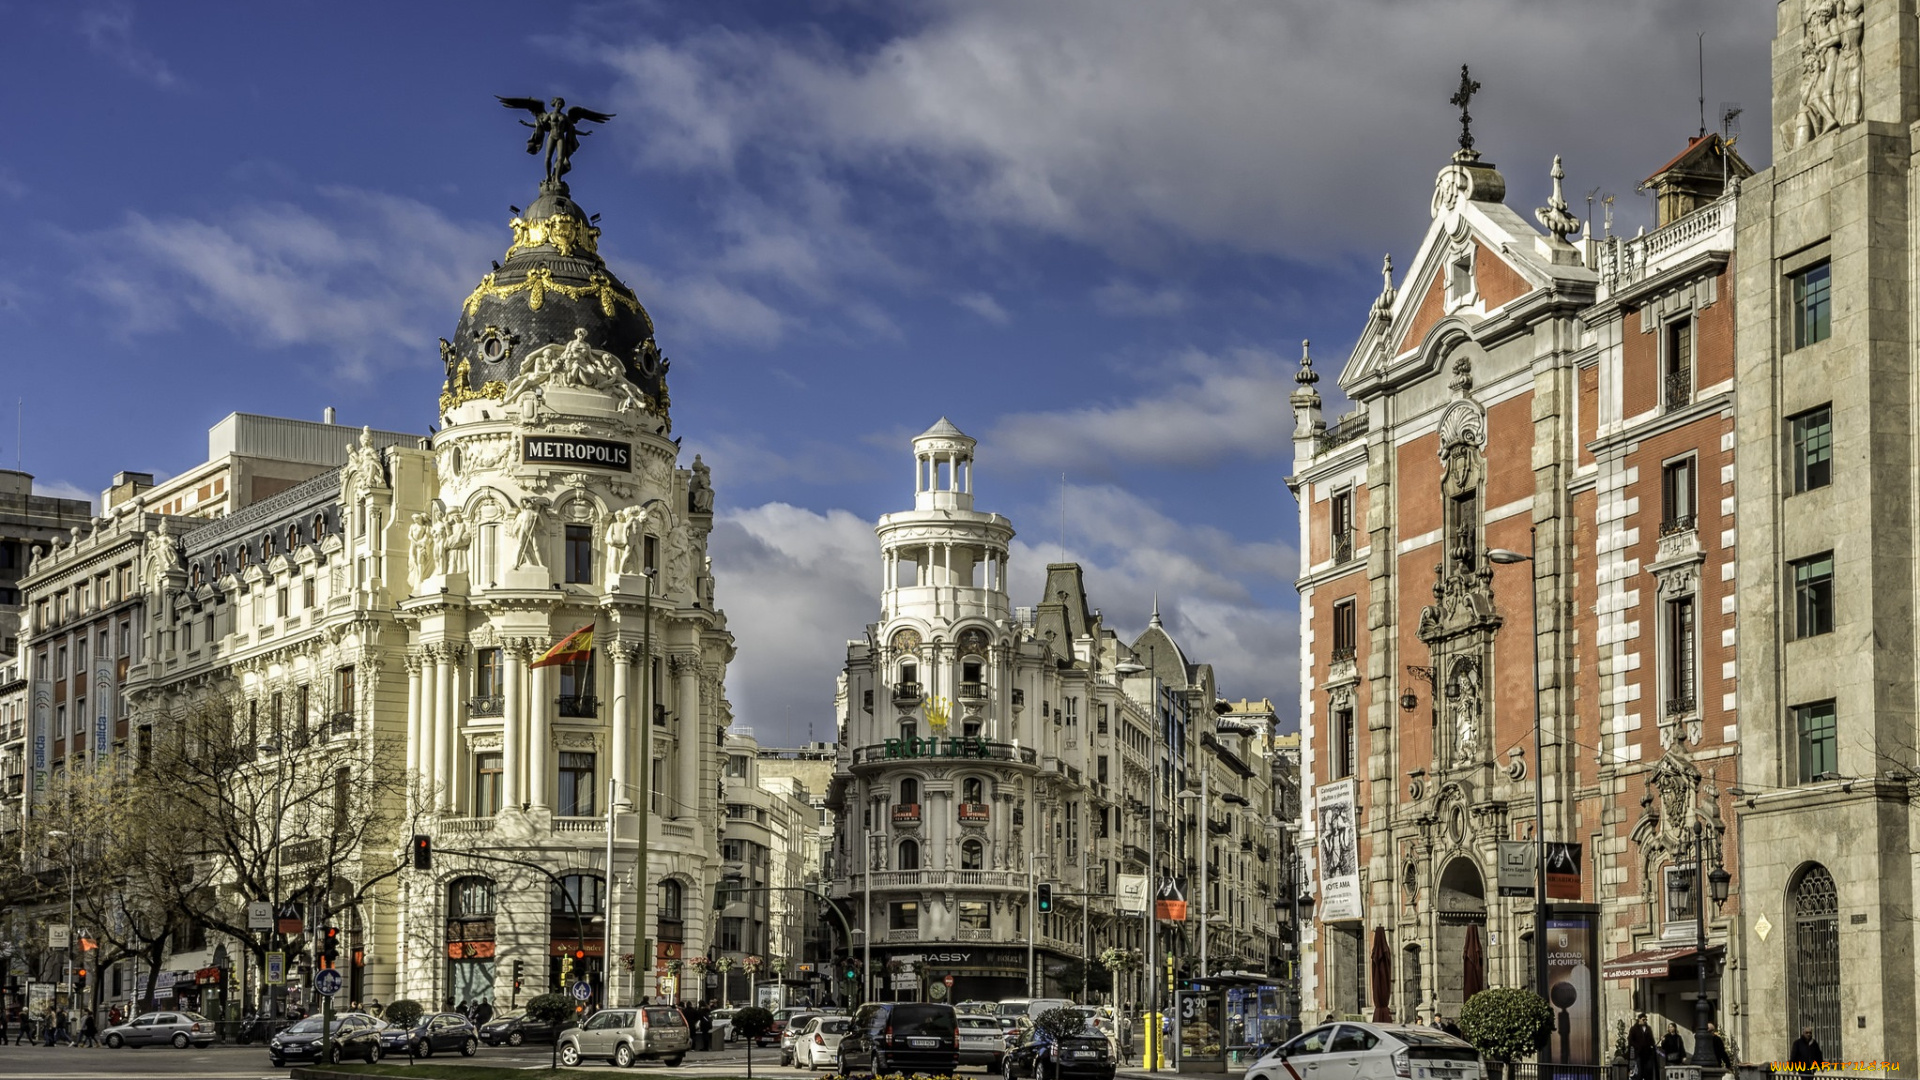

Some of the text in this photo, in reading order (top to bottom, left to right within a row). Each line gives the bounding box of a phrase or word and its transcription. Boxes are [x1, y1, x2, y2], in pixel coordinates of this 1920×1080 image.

[529, 441, 627, 464] METROPOLIS
[96, 716, 108, 750] salida
[35, 735, 46, 769] salida
[884, 735, 993, 759] ROLEX
[914, 953, 971, 962] RASSY
